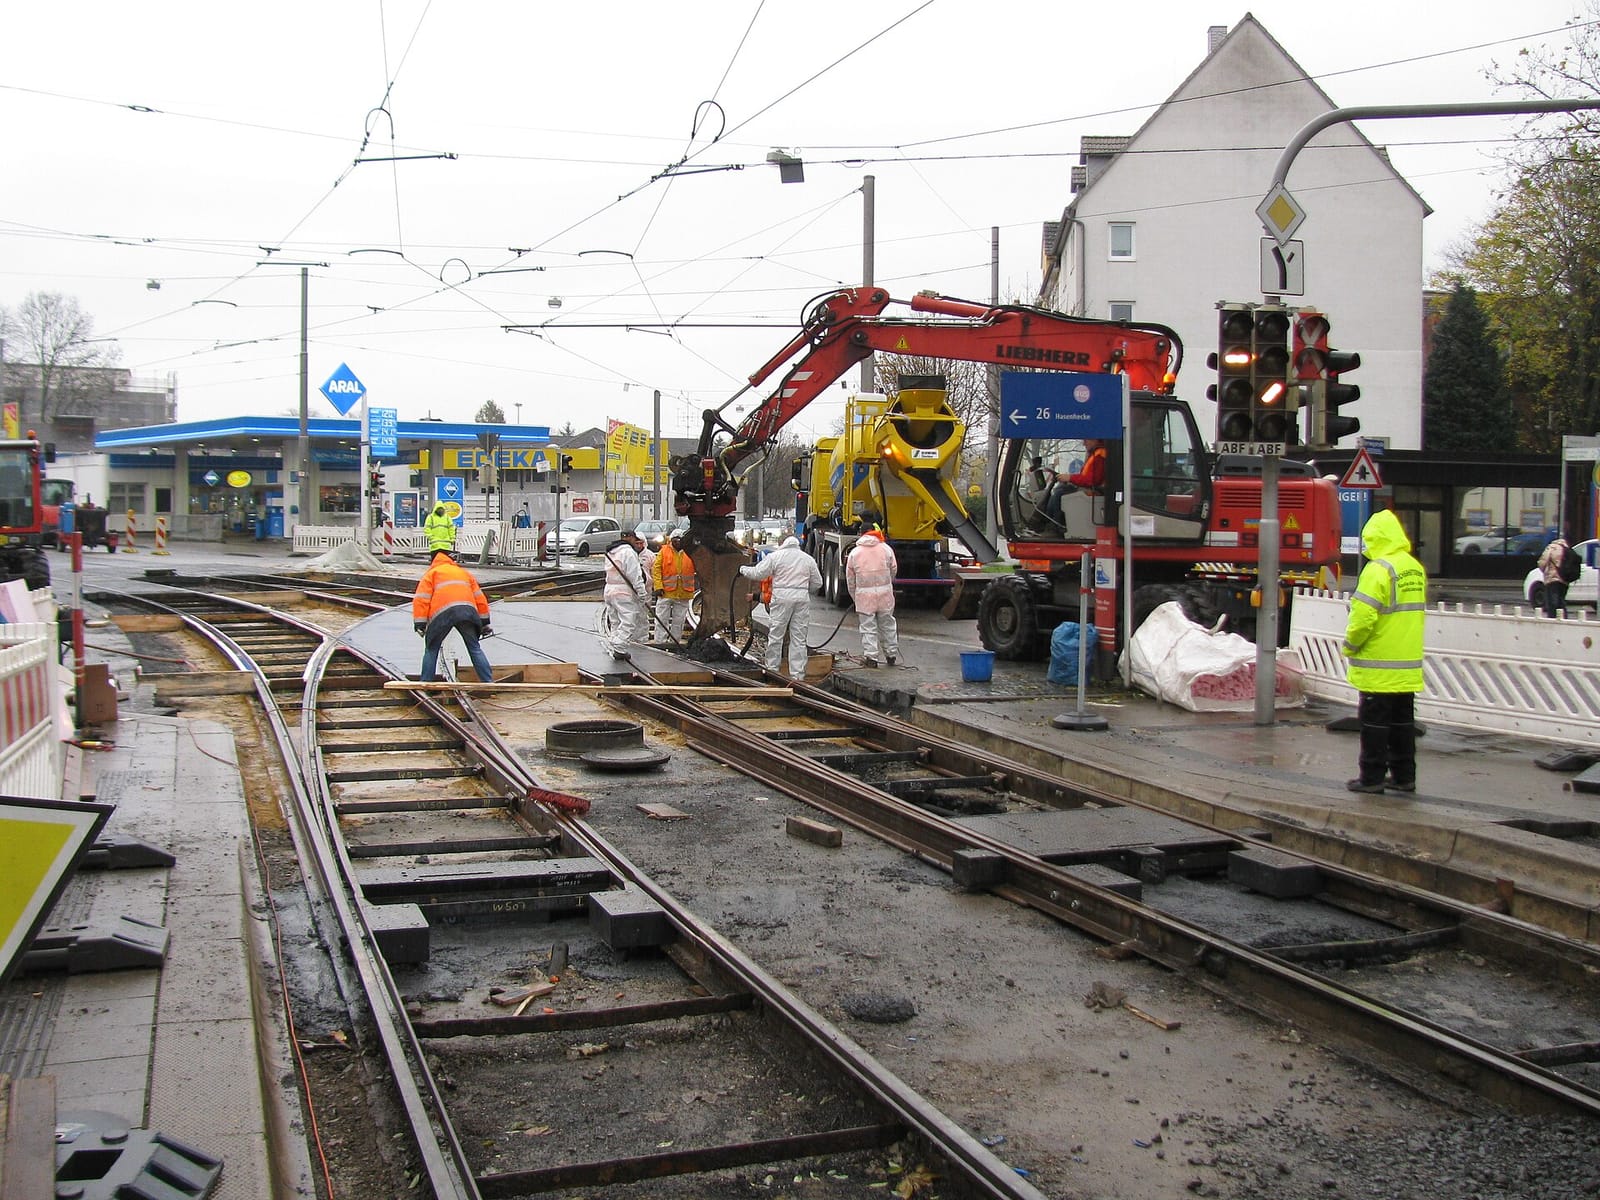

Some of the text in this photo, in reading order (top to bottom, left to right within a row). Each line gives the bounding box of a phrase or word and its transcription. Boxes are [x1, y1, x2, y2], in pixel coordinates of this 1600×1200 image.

[996, 344, 1091, 366] LIEBHERR
[328, 380, 362, 393] ARAL
[1036, 407, 1050, 420] 26
[1221, 442, 1246, 454] ABF
[1256, 443, 1281, 455] ABF
[457, 450, 547, 468] EDEKA
